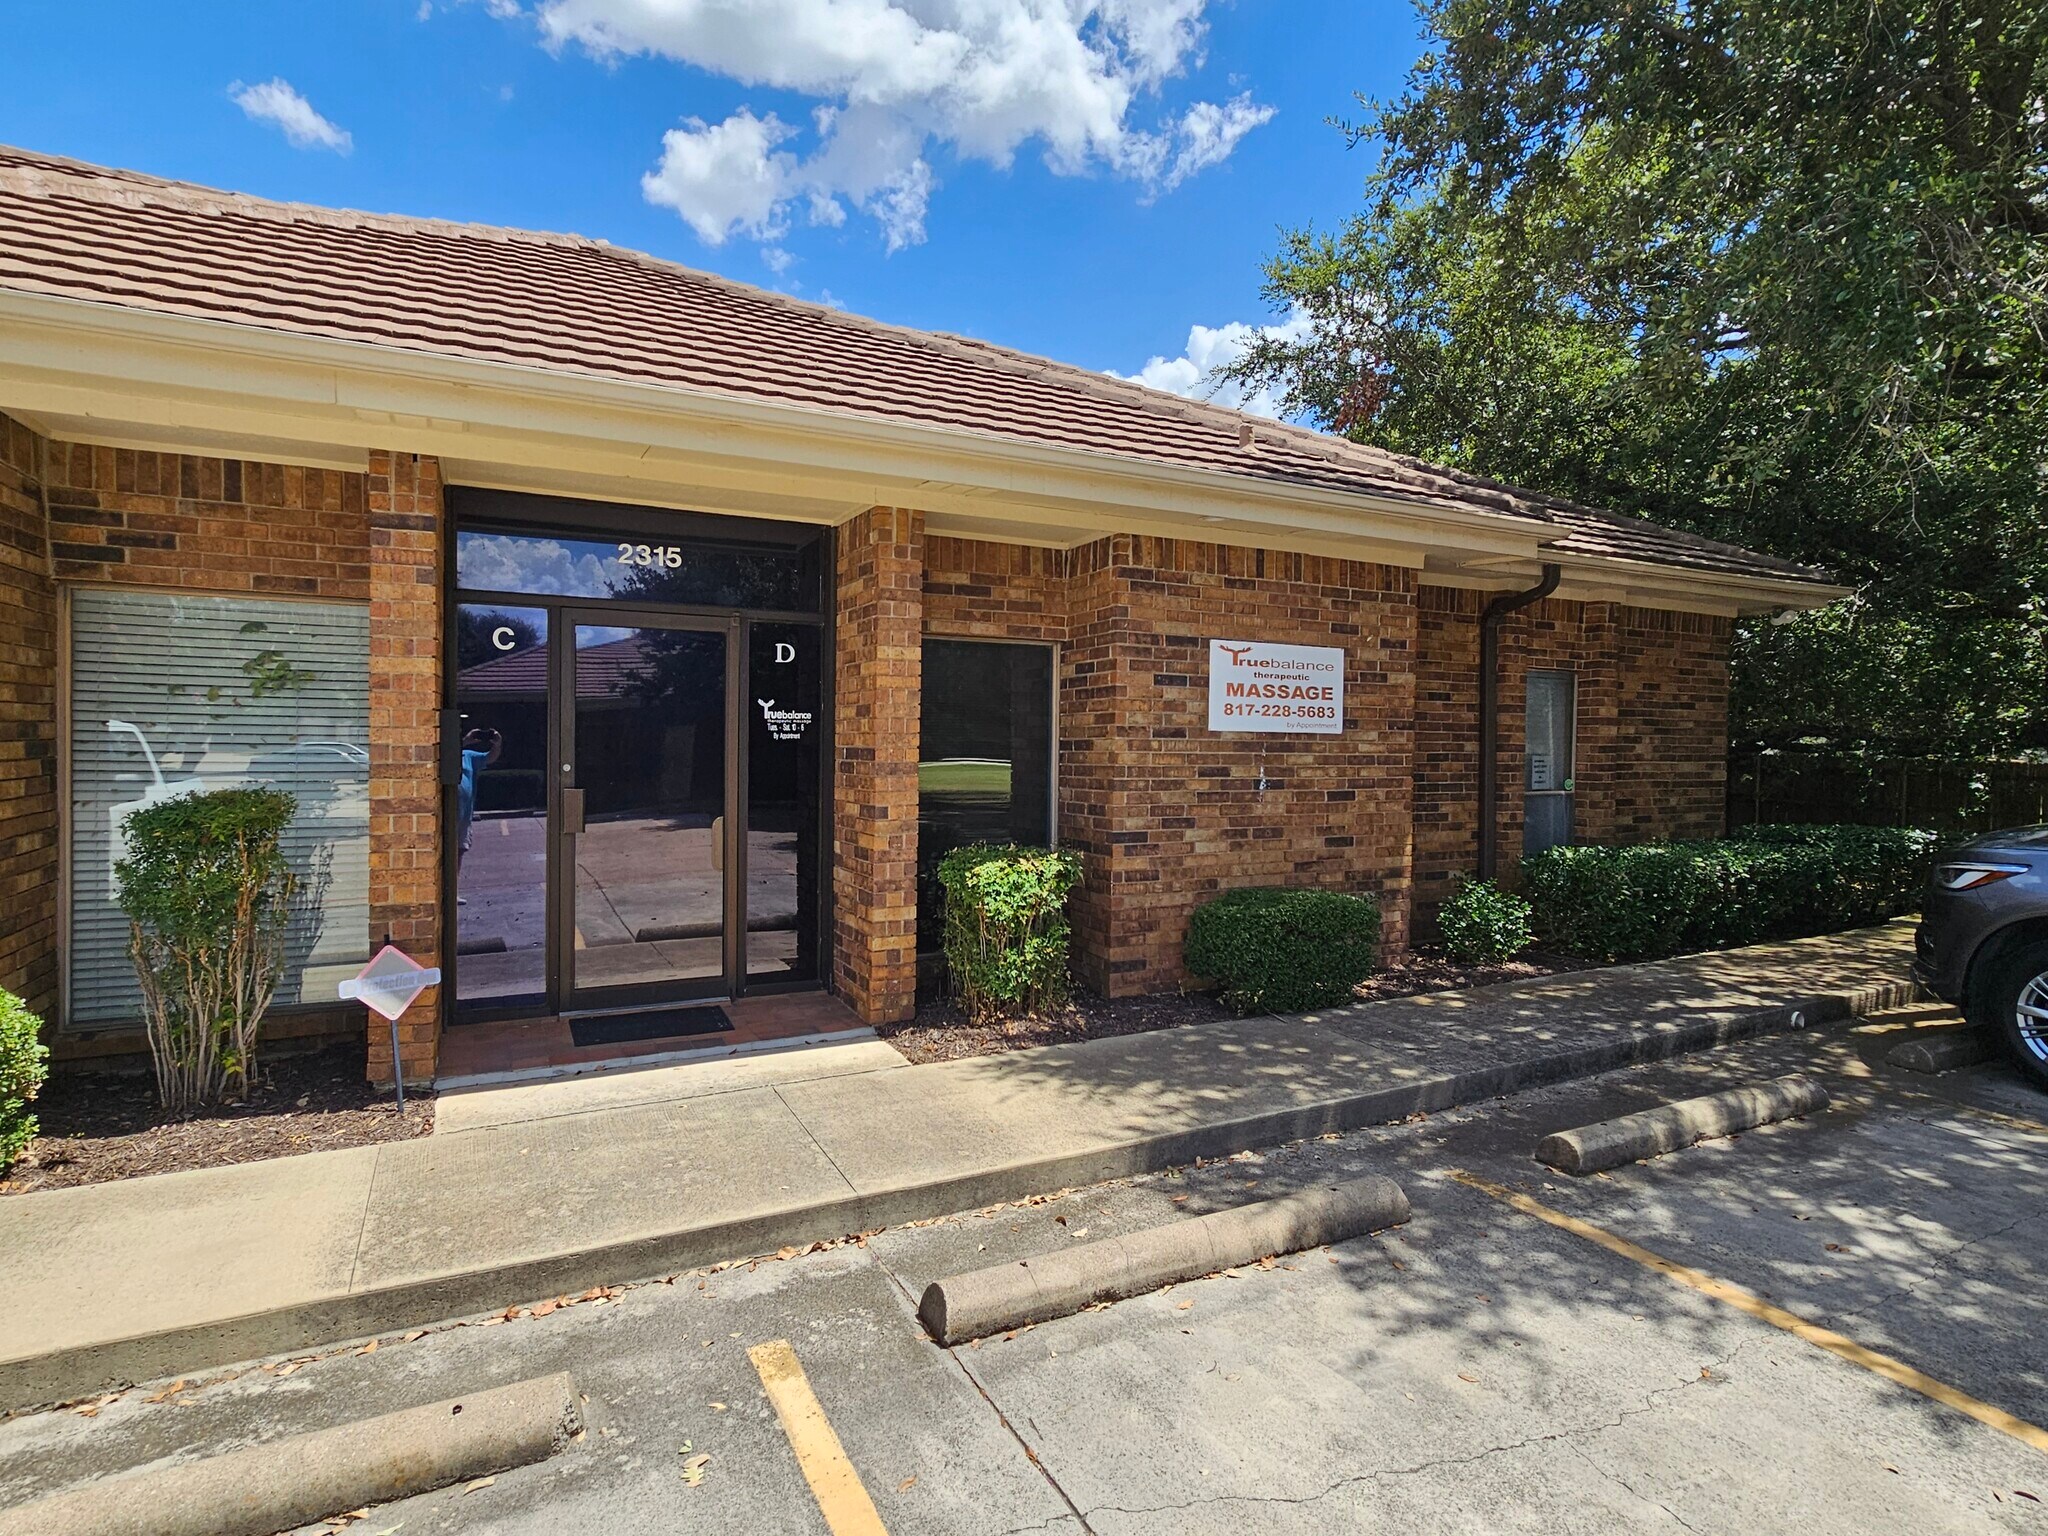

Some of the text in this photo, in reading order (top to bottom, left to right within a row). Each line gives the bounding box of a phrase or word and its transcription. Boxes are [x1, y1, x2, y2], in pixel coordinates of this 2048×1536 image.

[618, 543, 682, 568] 2315
[492, 626, 516, 651] C
[774, 643, 796, 663] D
[1218, 644, 1335, 672] Truebalance
[1253, 671, 1310, 681] therapeutic
[1226, 682, 1334, 701] MASSAGE
[757, 698, 812, 719] Truebalance
[1223, 703, 1335, 719] 817-228-5683
[1286, 721, 1338, 729] by Appointment
